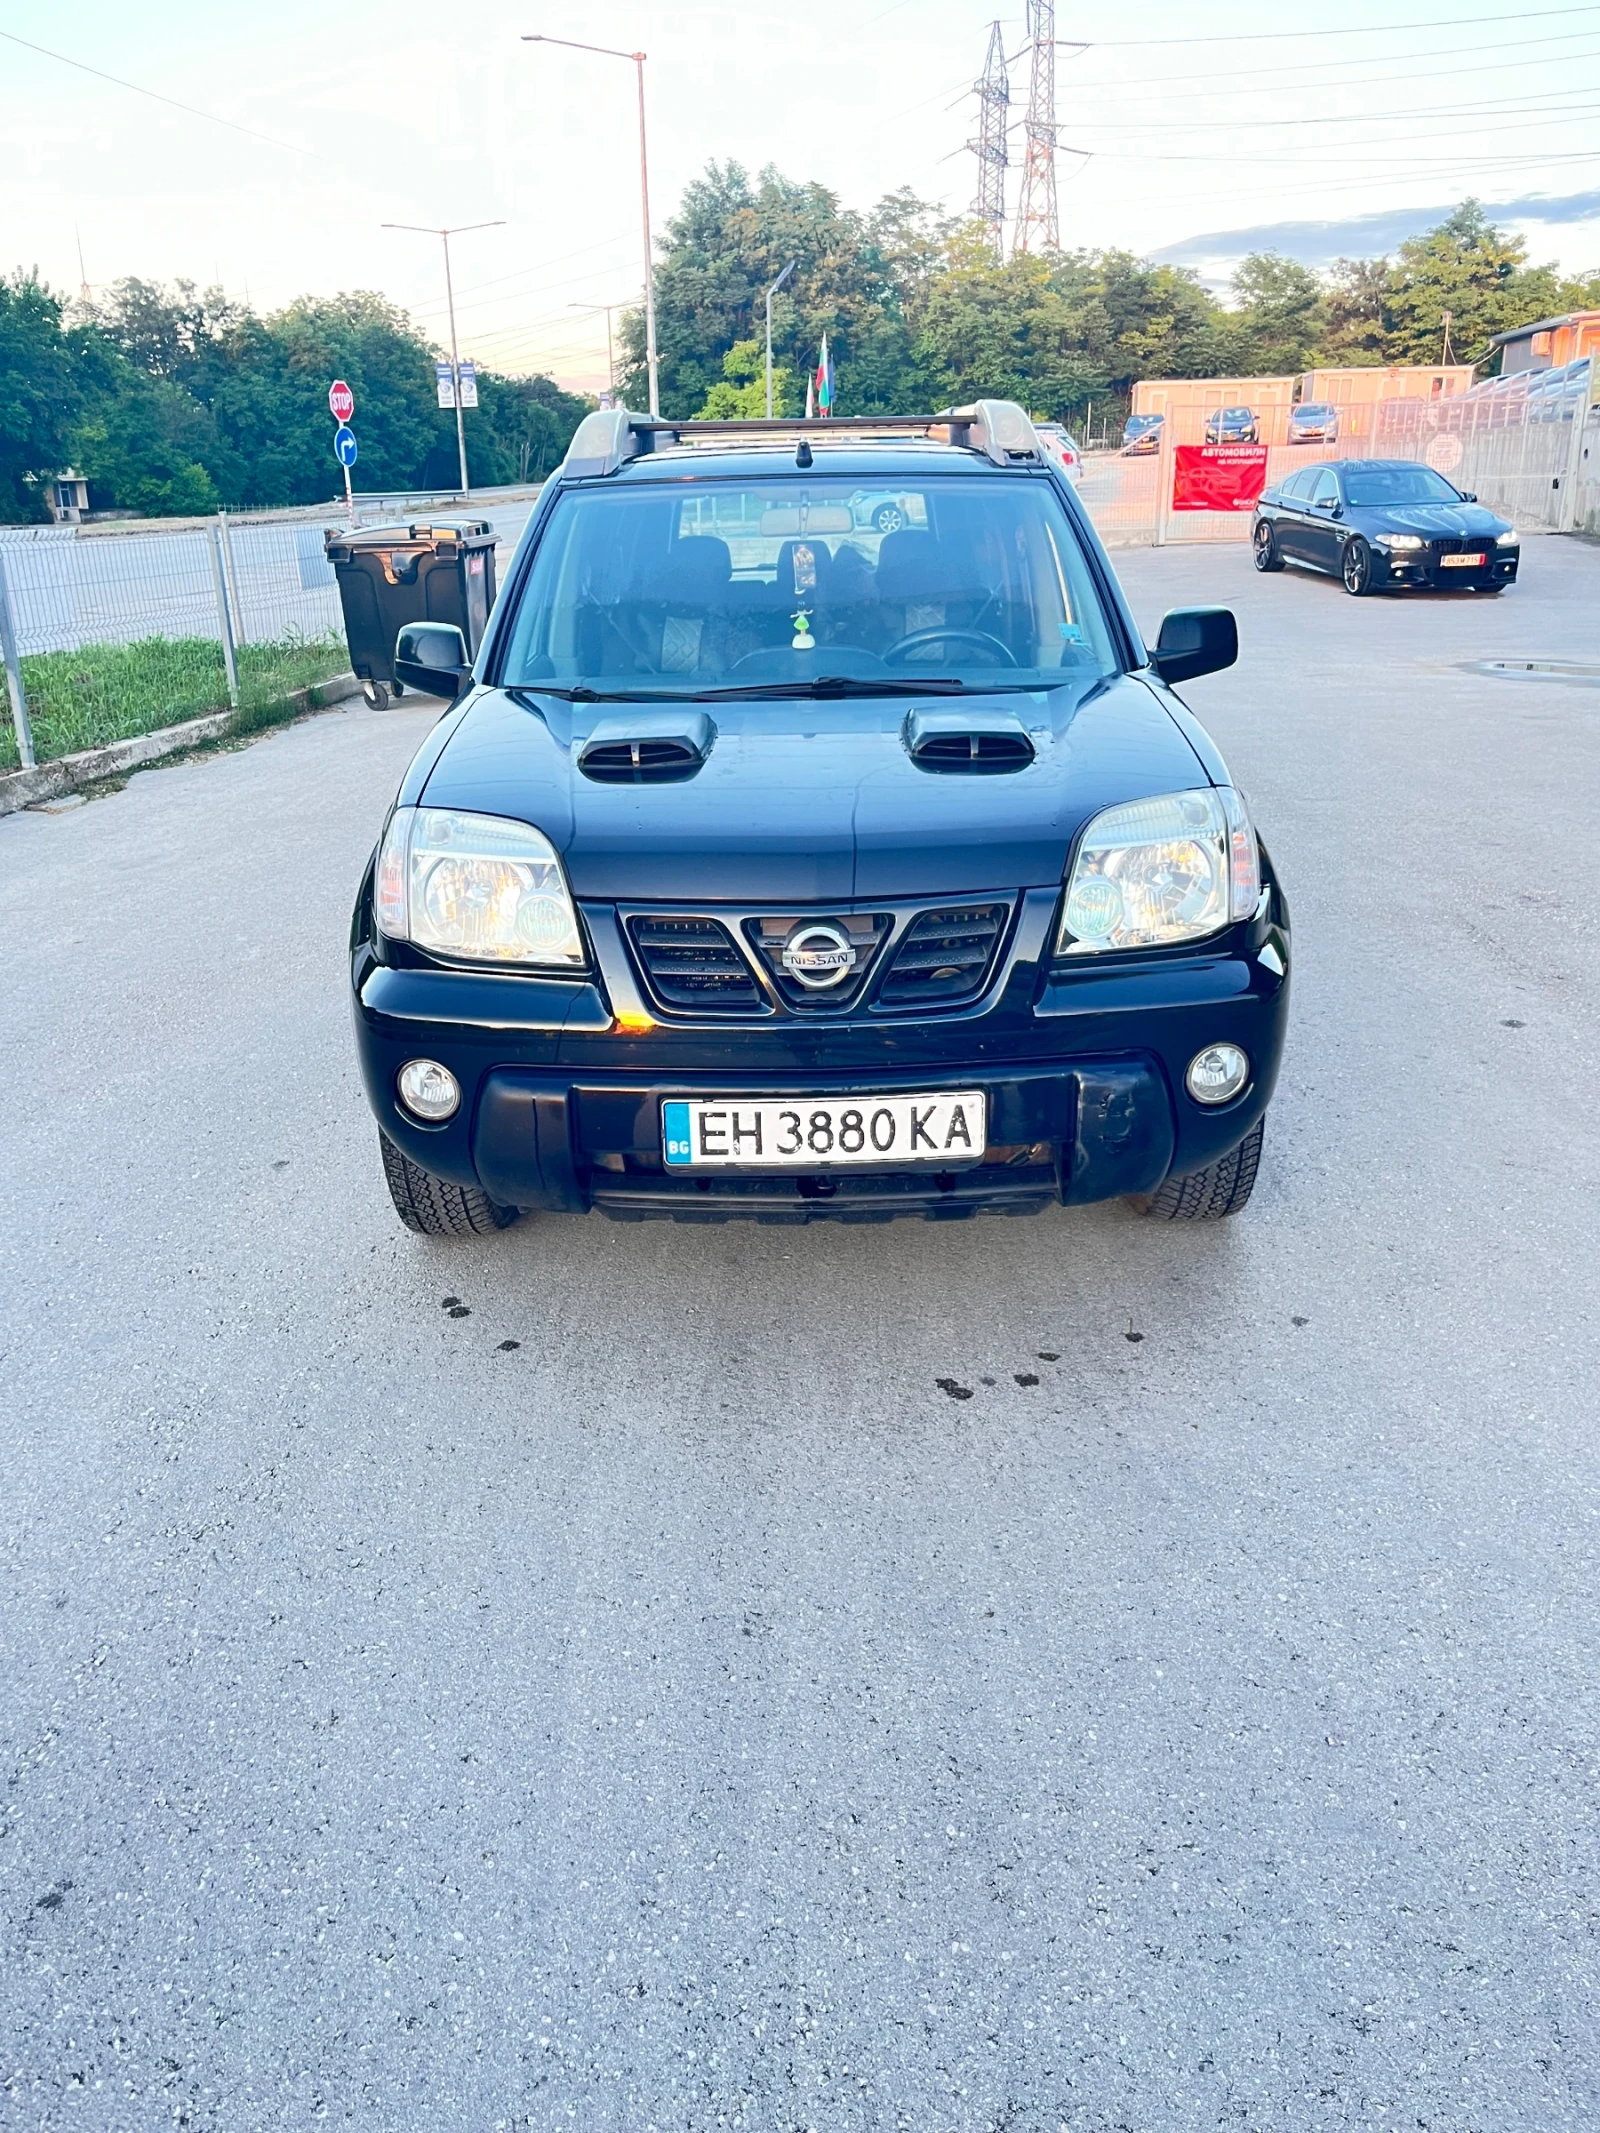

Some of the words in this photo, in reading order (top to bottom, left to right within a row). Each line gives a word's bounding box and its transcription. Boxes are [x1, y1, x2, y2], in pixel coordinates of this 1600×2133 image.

[332, 392, 351, 411] STOP
[1201, 447, 1266, 457] АВТОМОБИЛИ
[791, 954, 848, 966] NISSAN
[776, 1107, 896, 1155] 3880
[668, 1140, 690, 1155] BG
